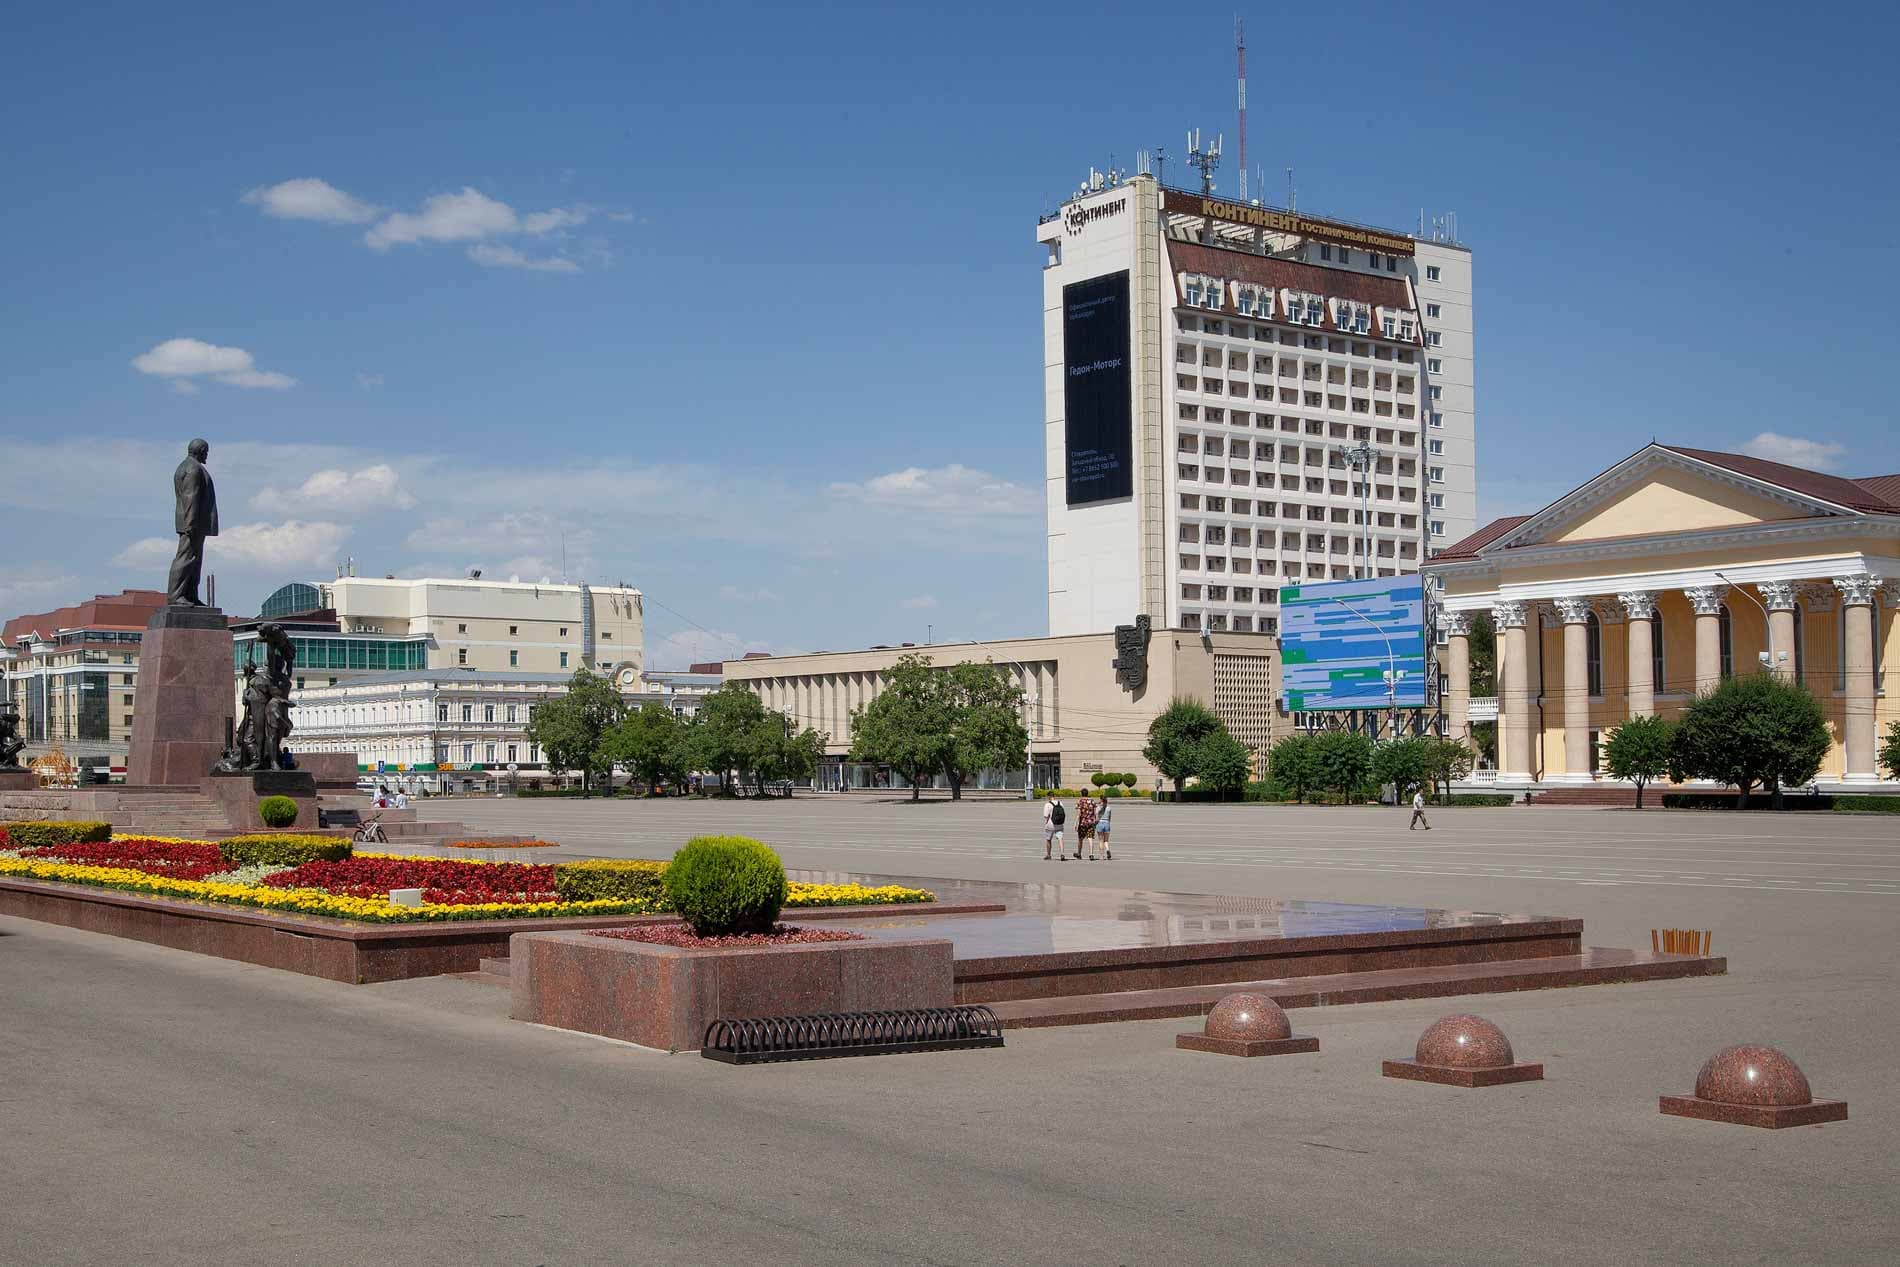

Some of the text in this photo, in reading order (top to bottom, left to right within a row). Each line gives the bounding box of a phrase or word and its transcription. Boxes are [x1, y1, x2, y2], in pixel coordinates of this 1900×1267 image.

[1070, 198, 1126, 228] КОНТИНЕНТ
[1202, 199, 1300, 232] КОНТИНЕНТ
[1069, 358, 1122, 376] Гедон-Моторс
